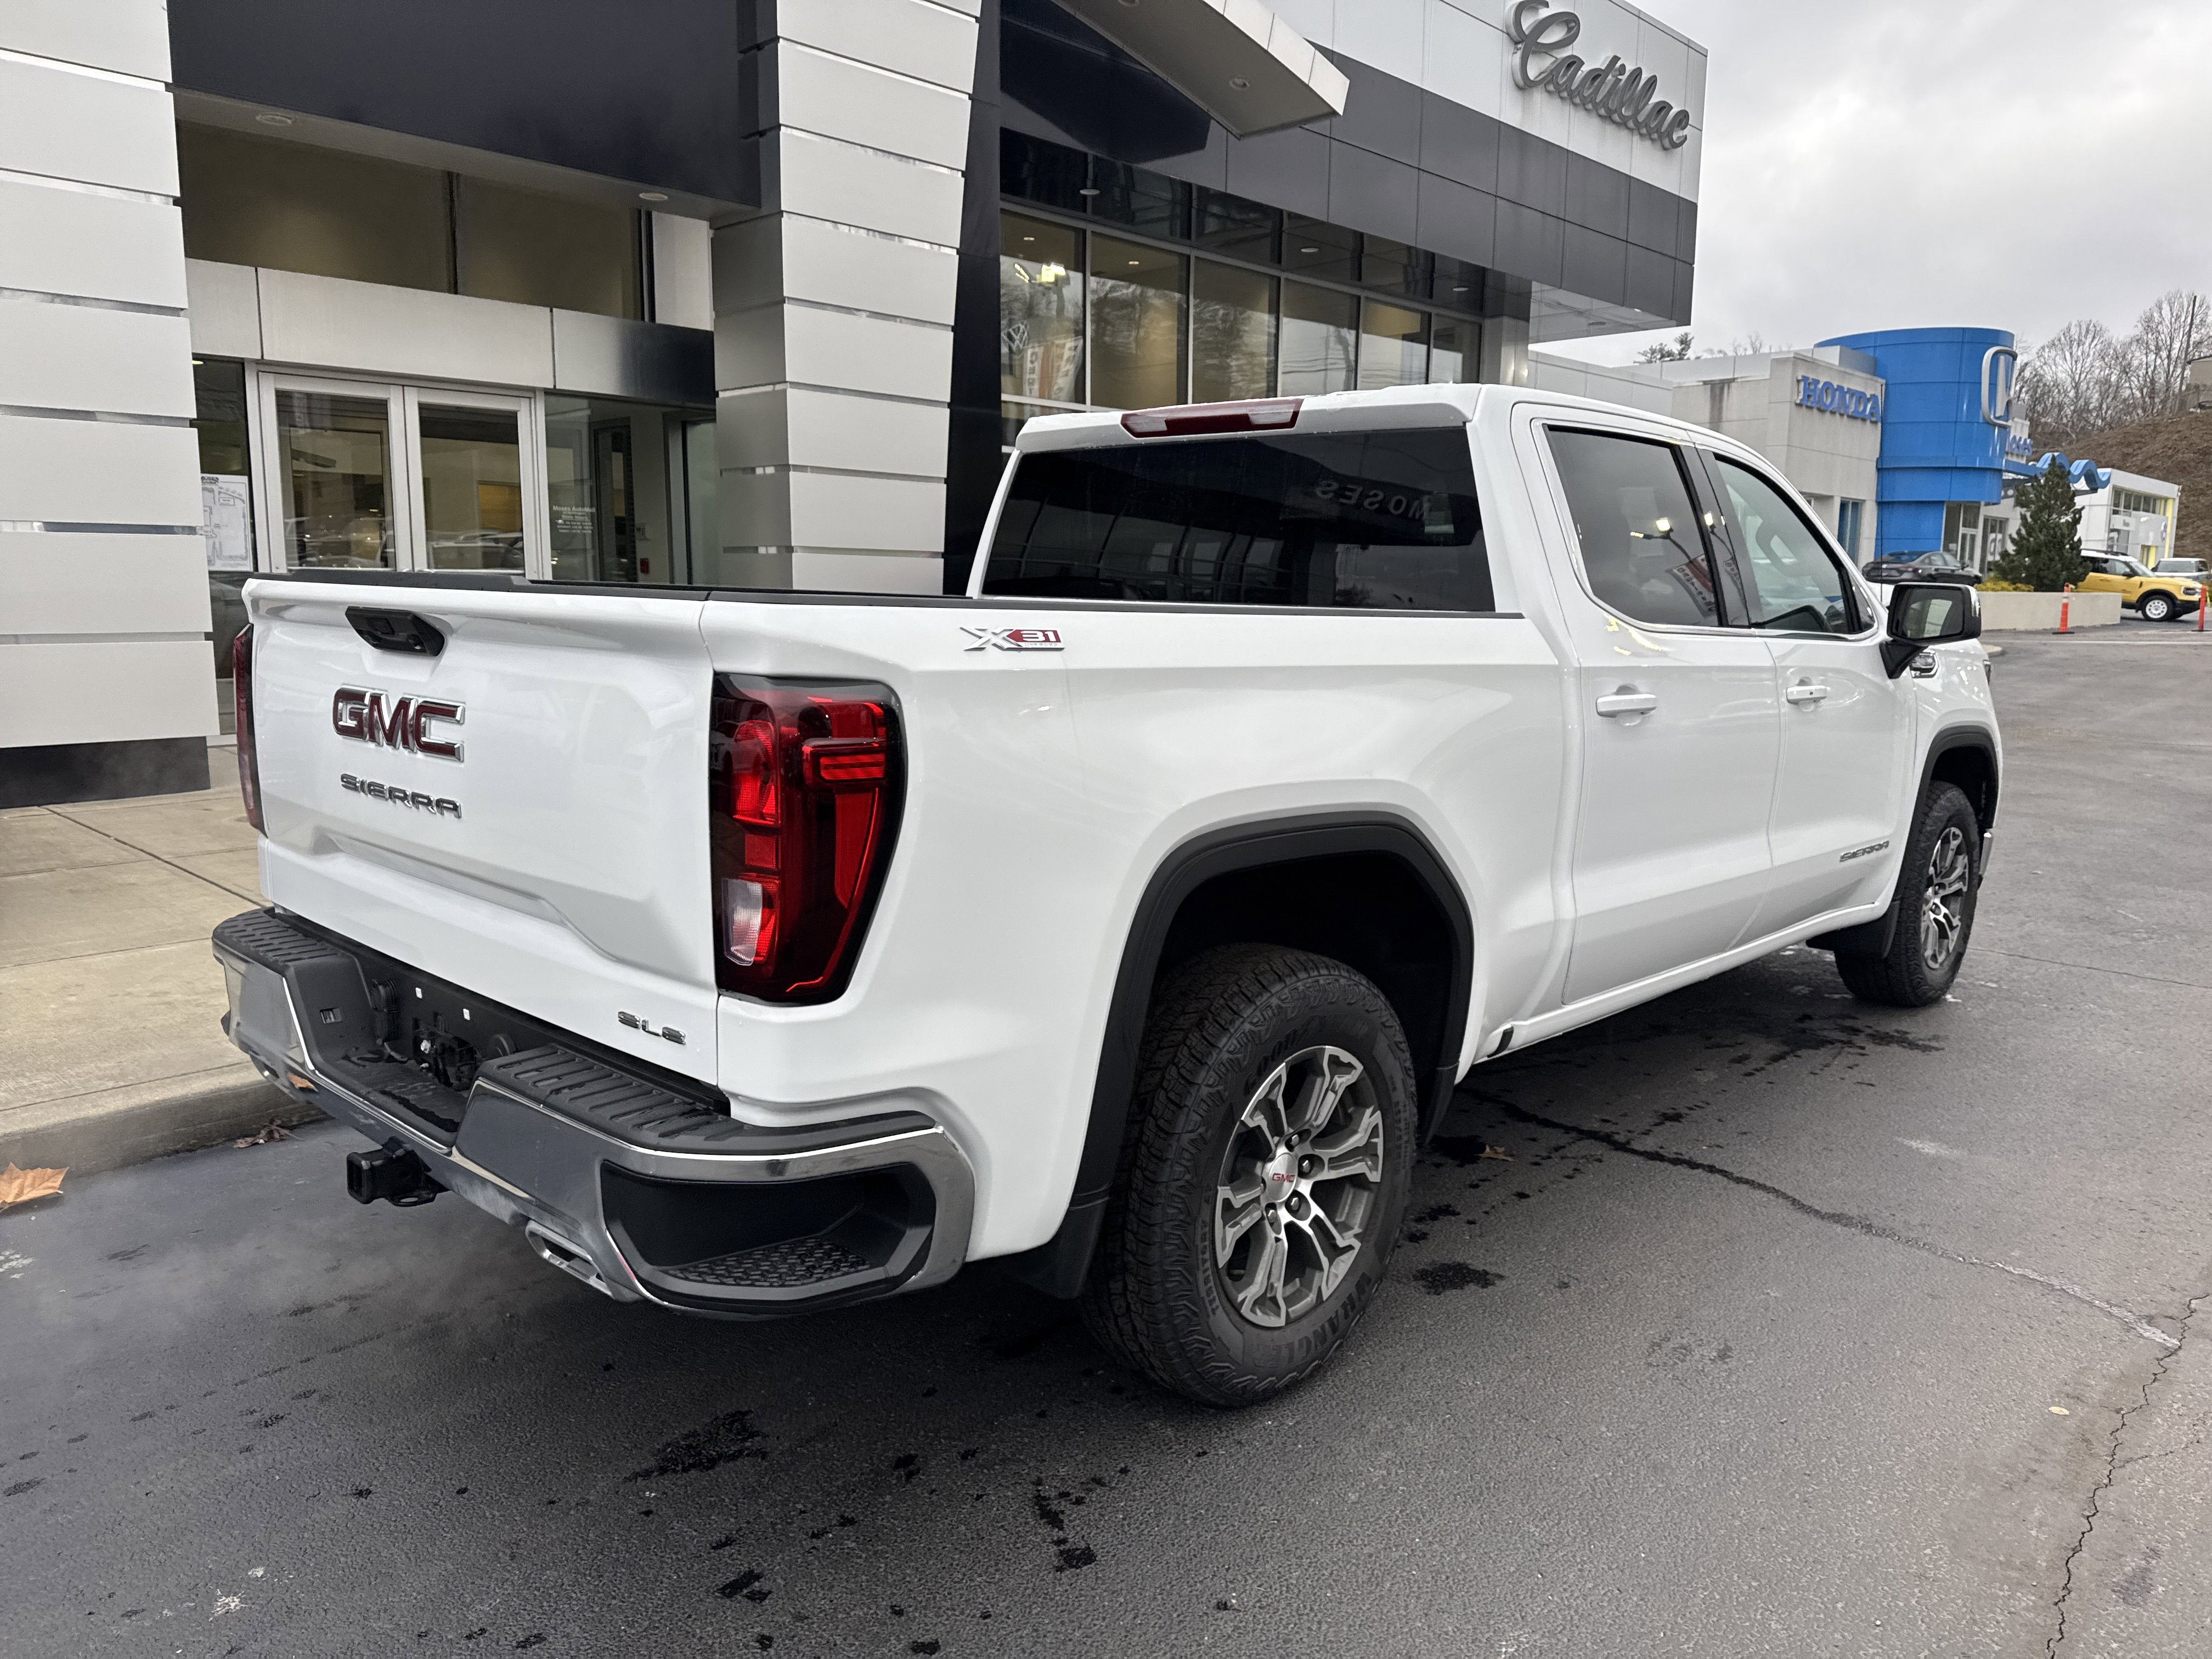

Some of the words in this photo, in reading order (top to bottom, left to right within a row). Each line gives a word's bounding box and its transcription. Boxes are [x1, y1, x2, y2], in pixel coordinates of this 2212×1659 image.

[1508, 0, 1690, 150] Cadillac
[1797, 375, 1882, 422] HONDA
[2006, 435, 2033, 456] oses
[332, 685, 465, 762] GMC
[340, 772, 462, 819] SIERRA
[1839, 840, 1889, 862] SIERRA
[618, 1011, 686, 1045] SLE
[1272, 1173, 1295, 1183] GMC
